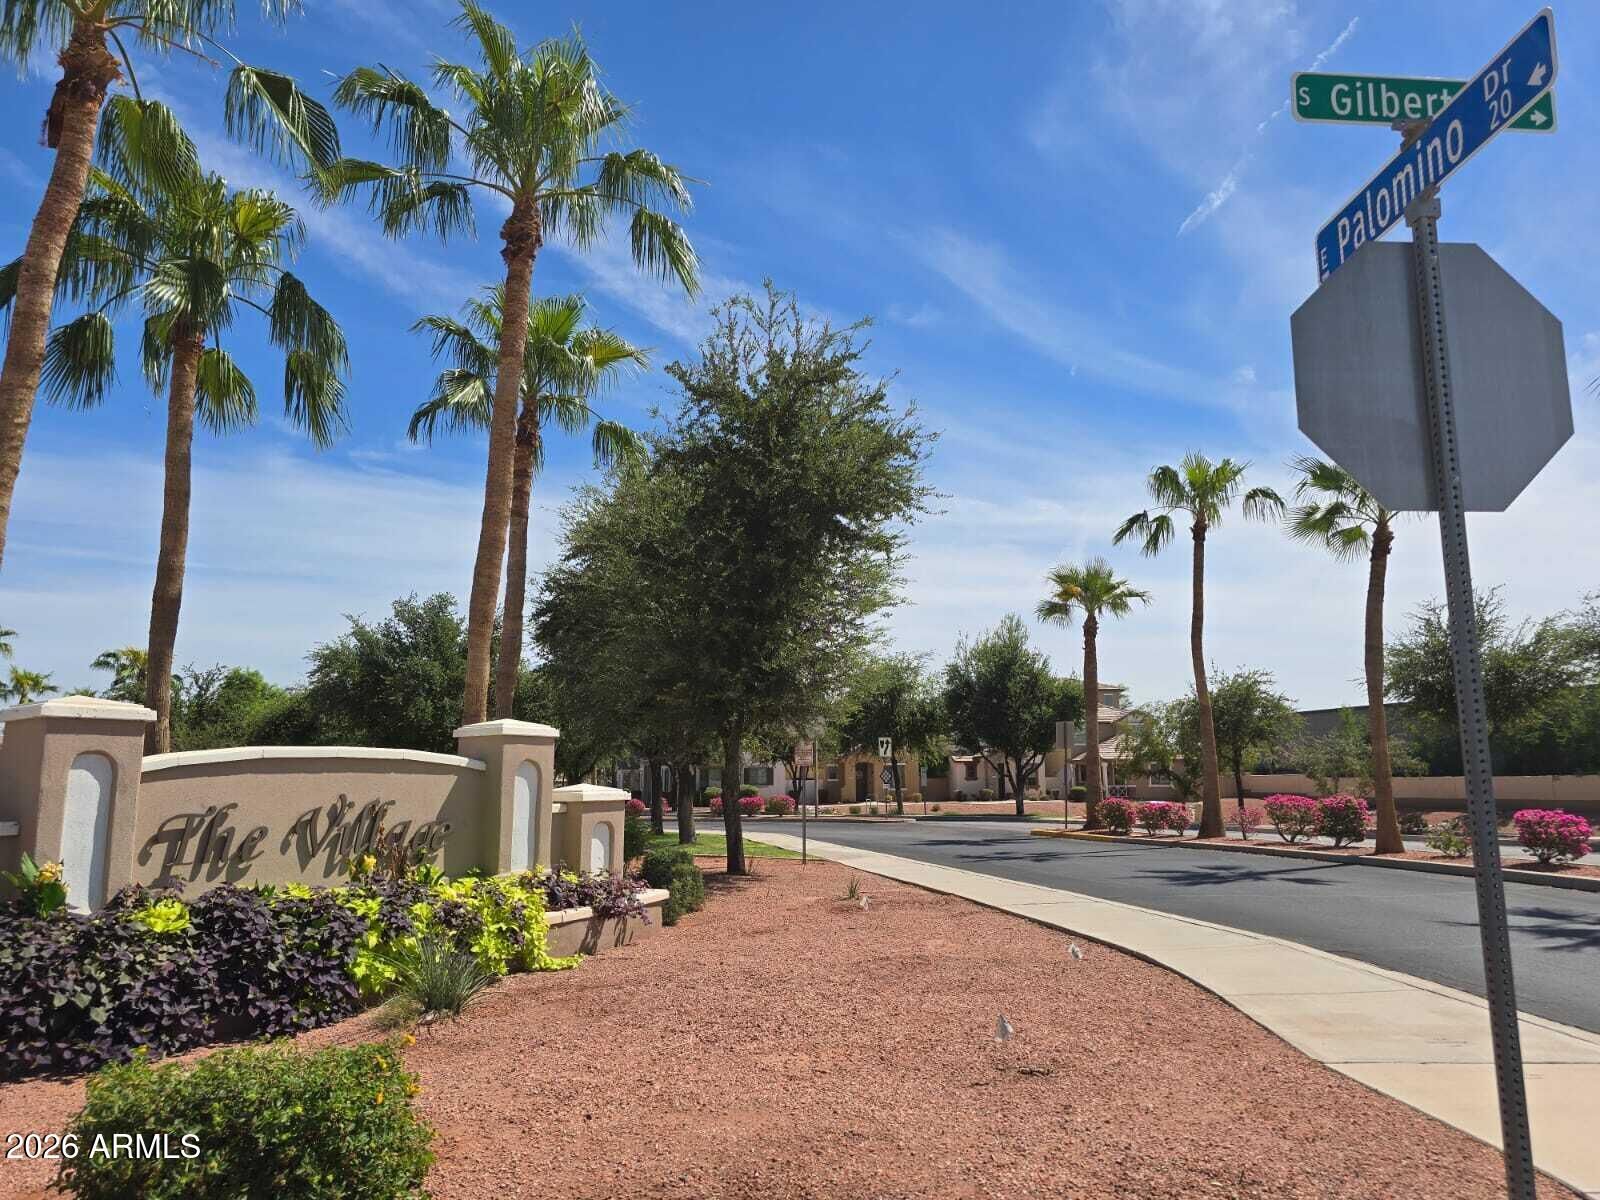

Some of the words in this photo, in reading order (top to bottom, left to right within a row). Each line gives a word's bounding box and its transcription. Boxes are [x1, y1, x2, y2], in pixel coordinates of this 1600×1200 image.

[1299, 87, 1311, 106] S
[1330, 81, 1453, 119] Gilbert
[1488, 89, 1512, 130] 20
[1320, 246, 1329, 270] E
[1337, 119, 1464, 265] Palomino
[1483, 58, 1512, 102] Dr
[143, 802, 269, 868] The
